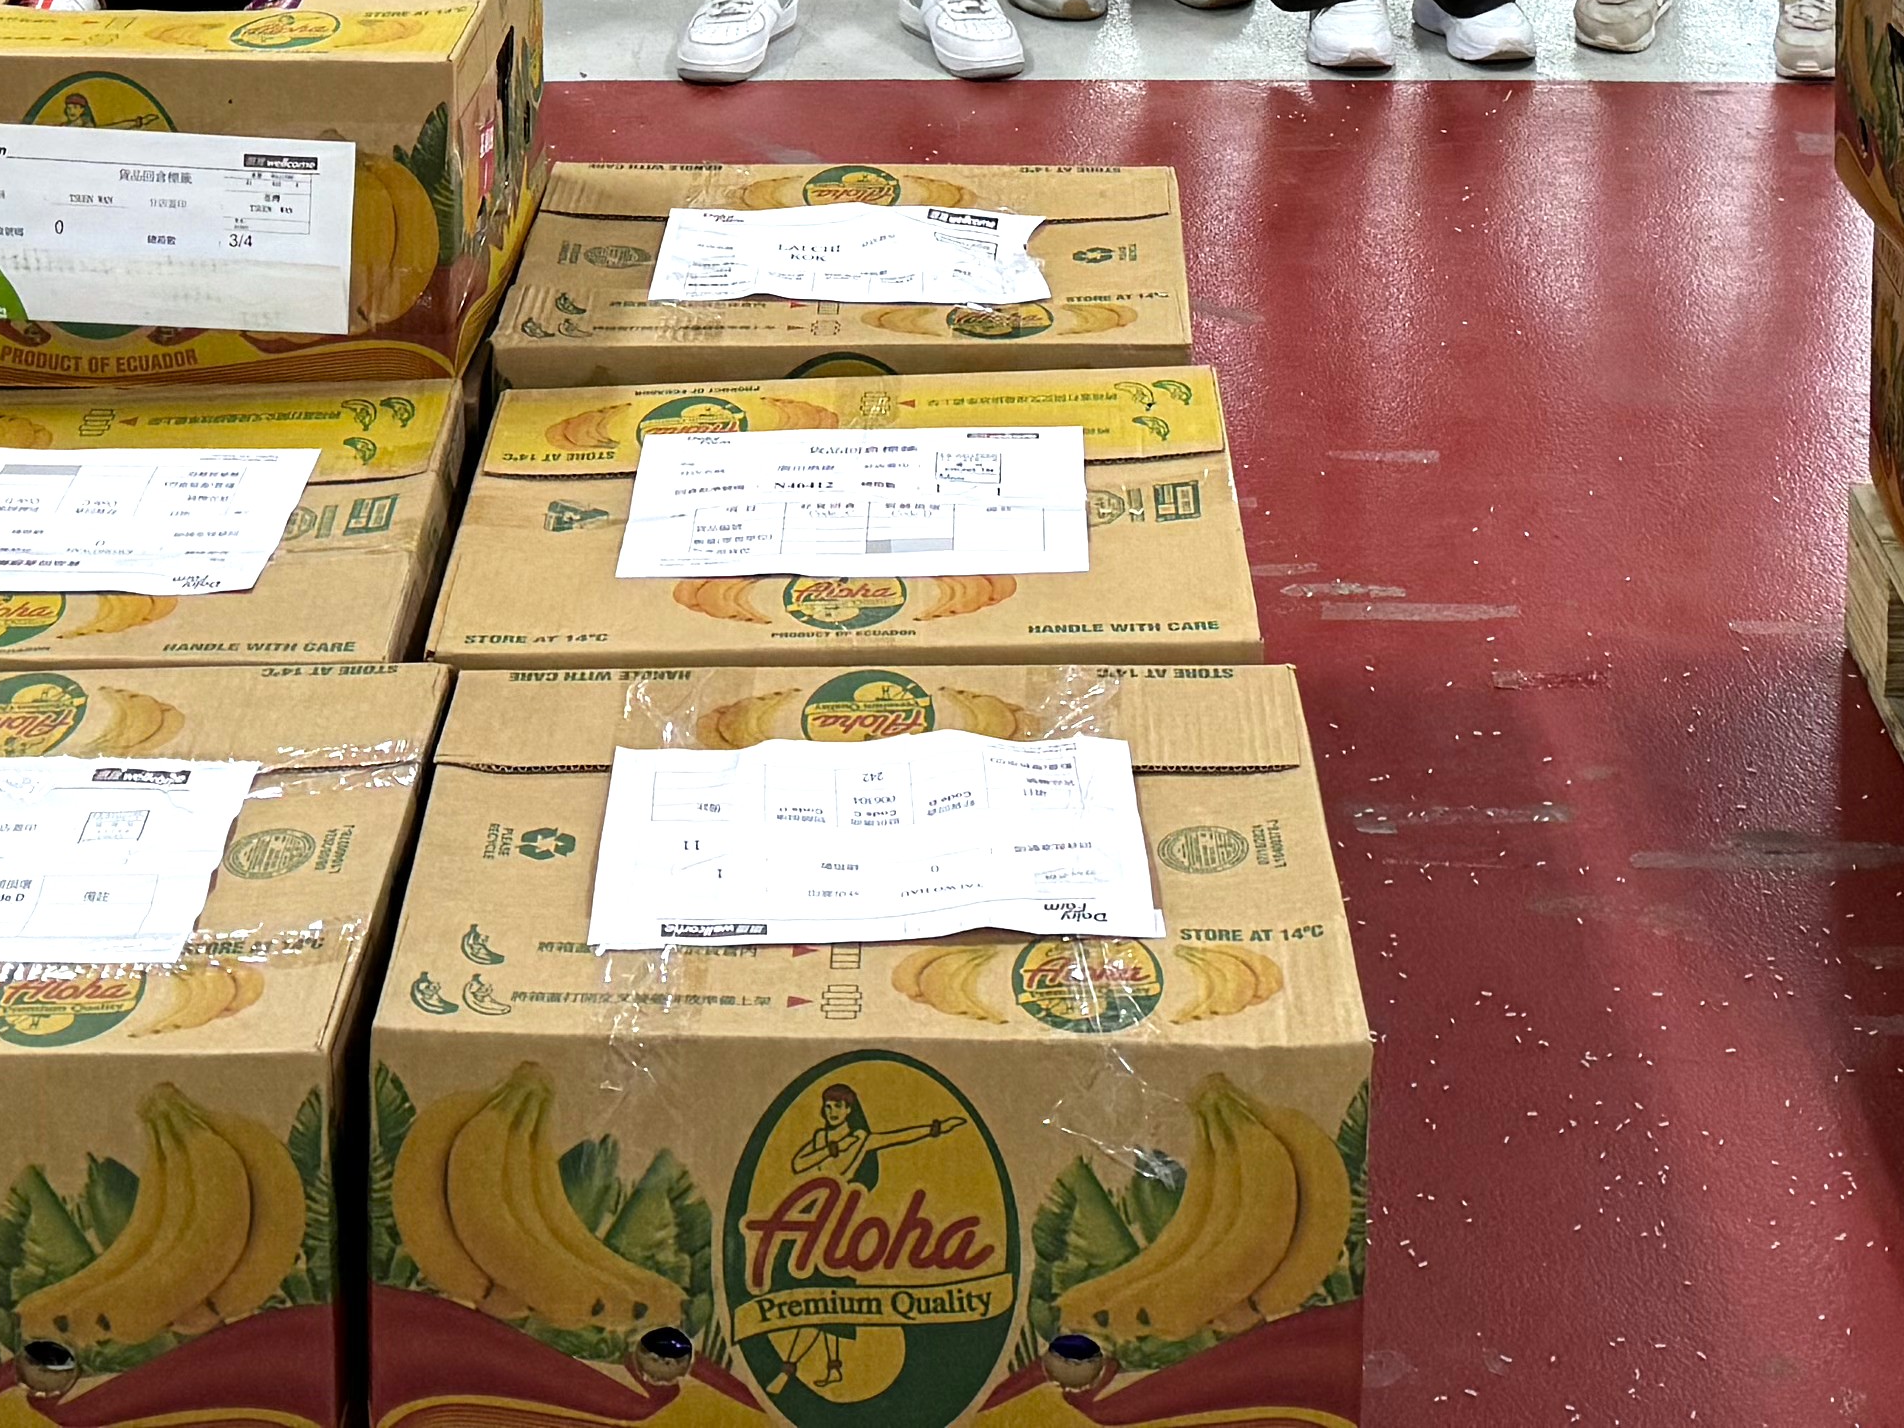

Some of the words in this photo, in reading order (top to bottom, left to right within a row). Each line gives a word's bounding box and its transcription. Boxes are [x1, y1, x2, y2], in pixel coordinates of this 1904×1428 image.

[265, 159, 318, 171] wellcome
[53, 219, 65, 235] 0
[228, 232, 254, 249] 3/4
[789, 252, 828, 263] KOK
[0, 345, 91, 374] PRODUCT
[94, 356, 110, 375] OF
[115, 347, 199, 375] ECUADOR
[502, 451, 536, 463] 14°C
[540, 451, 562, 463] AT
[567, 451, 615, 463] STORE
[795, 579, 897, 603] Aloha
[1028, 619, 1108, 635] HANDLE
[1111, 619, 1162, 635] WITH
[1166, 619, 1221, 635] CARE
[464, 634, 528, 647] STORE
[533, 633, 562, 645] AT
[565, 631, 609, 645] 14°C
[770, 628, 832, 641] PRODUCT
[835, 628, 853, 641] OF
[855, 628, 918, 641] ECUADOR
[162, 641, 240, 653] HANDLE
[244, 641, 298, 653] WITH
[302, 641, 356, 653] CARE
[261, 664, 302, 678] 14°C
[307, 664, 333, 678] AT
[338, 664, 399, 678] STORE
[509, 670, 557, 684] CARE
[561, 670, 613, 684] WITH
[618, 670, 692, 684] HANDLE
[1096, 668, 1139, 680] 14°C
[1145, 668, 1169, 680] AT
[1173, 668, 1234, 680] STORE
[811, 711, 924, 739] Aloha
[861, 771, 884, 783] 242
[483, 823, 500, 861] RECYCLE
[498, 827, 514, 860] PLEASE
[14, 892, 26, 904] D
[1043, 902, 1087, 913] Farm
[1061, 909, 1108, 923] Dairy
[1180, 928, 1246, 943] STORE
[1250, 927, 1274, 942] AT
[1279, 923, 1325, 942] 14°C
[1, 977, 133, 1005] Aloha
[1, 1001, 67, 1014] Premium
[69, 1000, 124, 1013] Quality
[744, 1173, 998, 1291] Aloha
[755, 1291, 884, 1325] Premium
[888, 1285, 993, 1323] Quality
